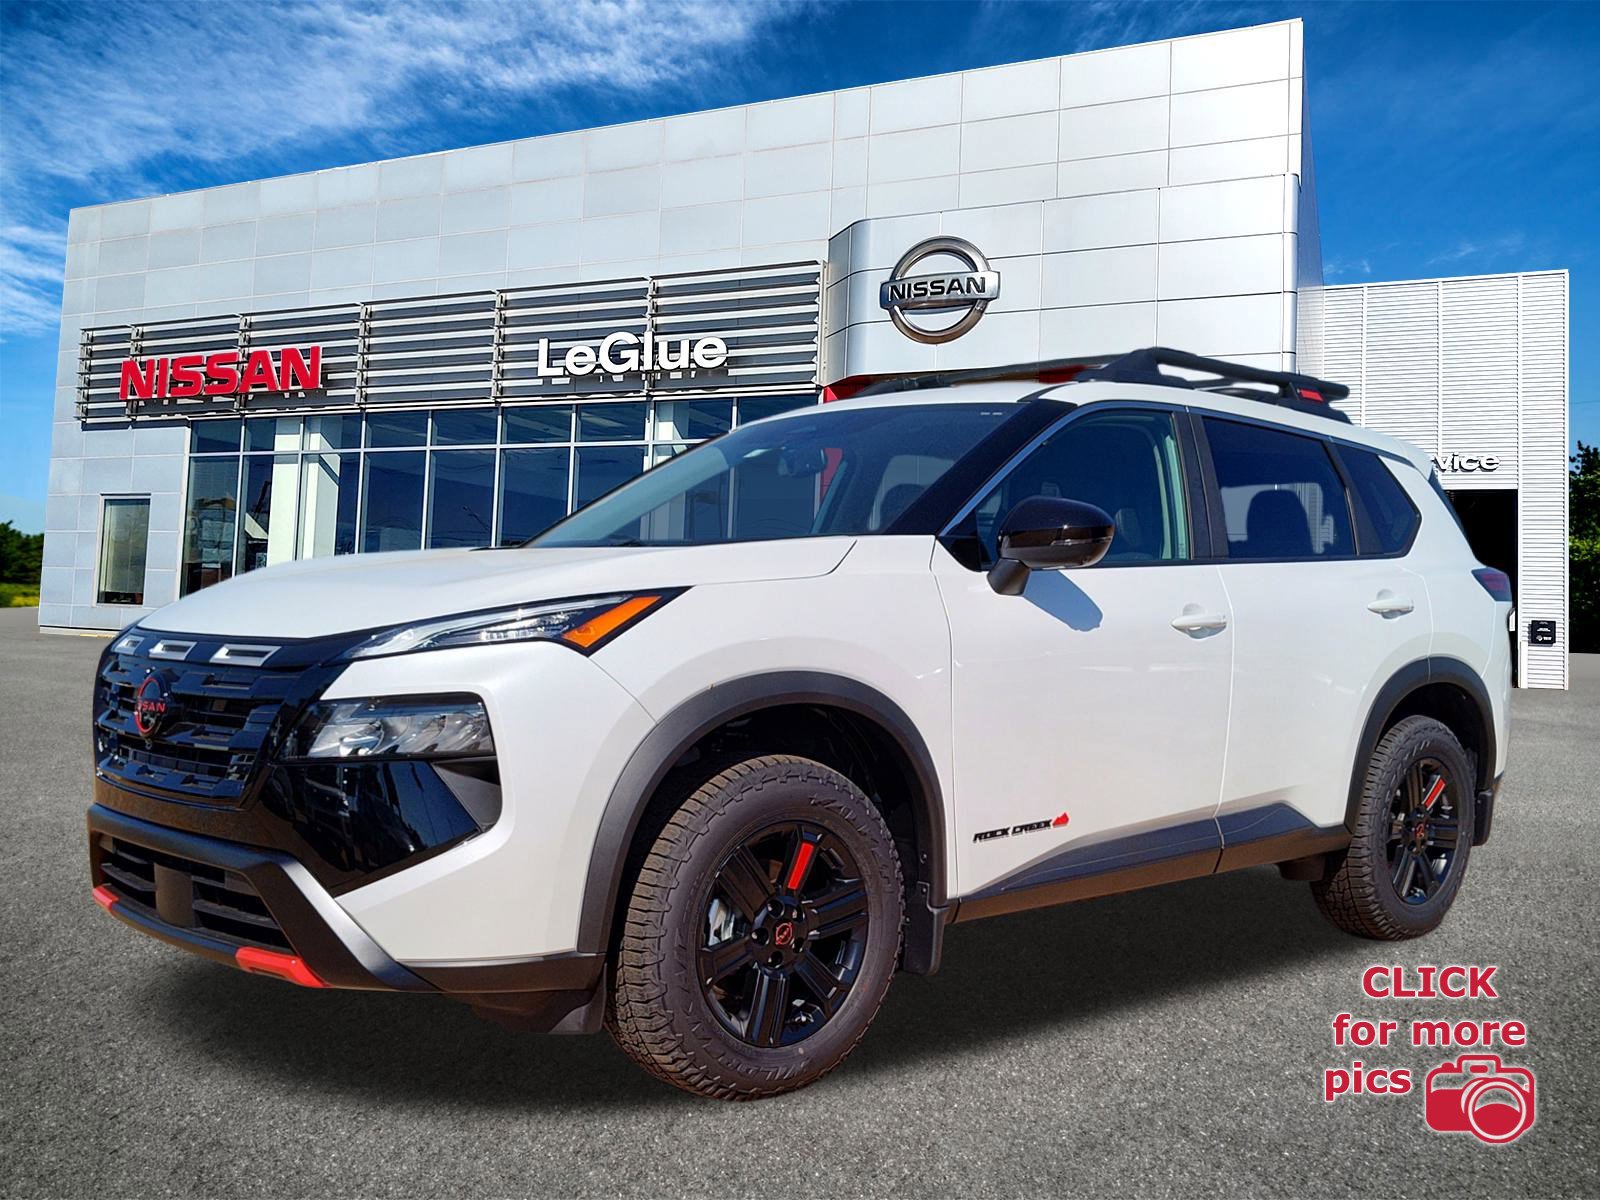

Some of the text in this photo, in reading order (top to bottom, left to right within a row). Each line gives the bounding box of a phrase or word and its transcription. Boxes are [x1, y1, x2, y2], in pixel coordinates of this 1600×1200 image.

[888, 276, 986, 301] NISSAN
[537, 331, 729, 376] LeGlue
[119, 345, 322, 400] NISSAN
[1431, 451, 1500, 472] vice
[972, 819, 1053, 843] ROCK CREEK
